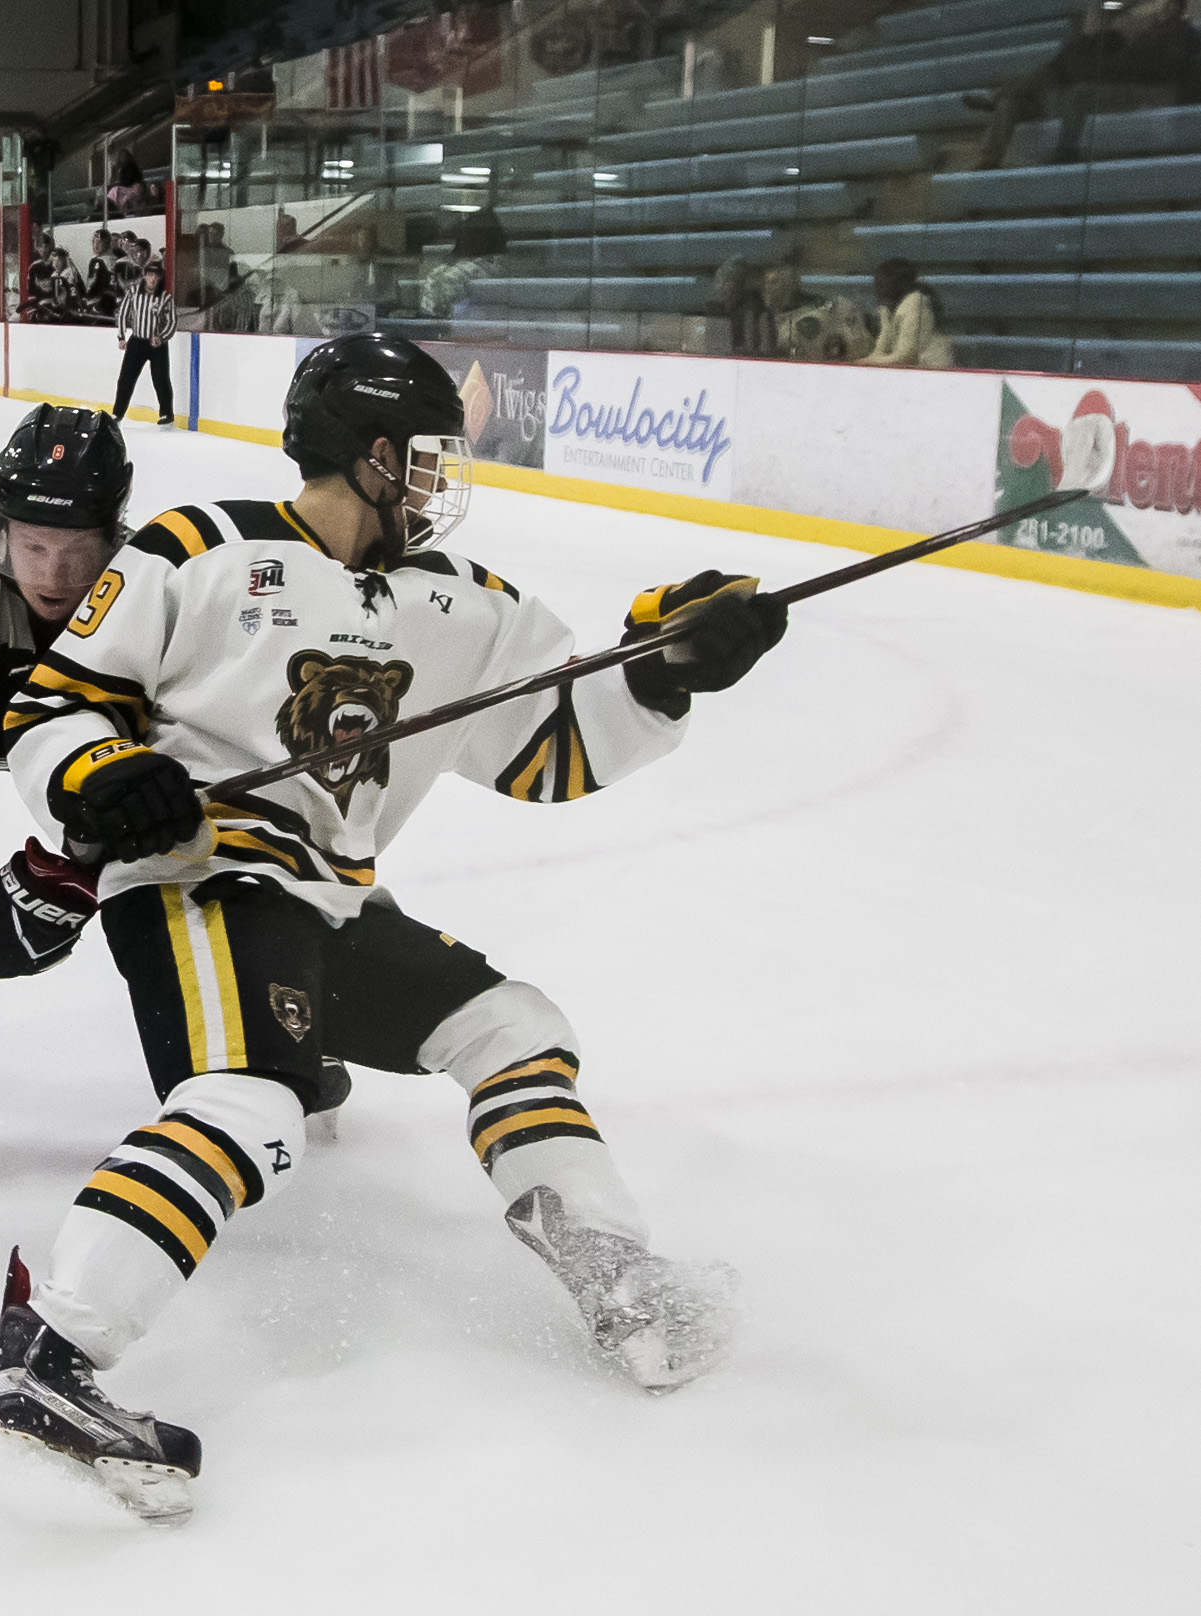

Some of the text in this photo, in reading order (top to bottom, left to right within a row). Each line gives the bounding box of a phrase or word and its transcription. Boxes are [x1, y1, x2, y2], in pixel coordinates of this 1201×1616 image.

[353, 384, 400, 401] BAUER
[493, 370, 547, 442] Twigs
[550, 366, 731, 486] Bowlocity
[52, 444, 65, 460] 8
[564, 445, 696, 482] ENTERTAINMENT CENTER
[26, 494, 74, 507] BAUER
[66, 568, 126, 640] 9
